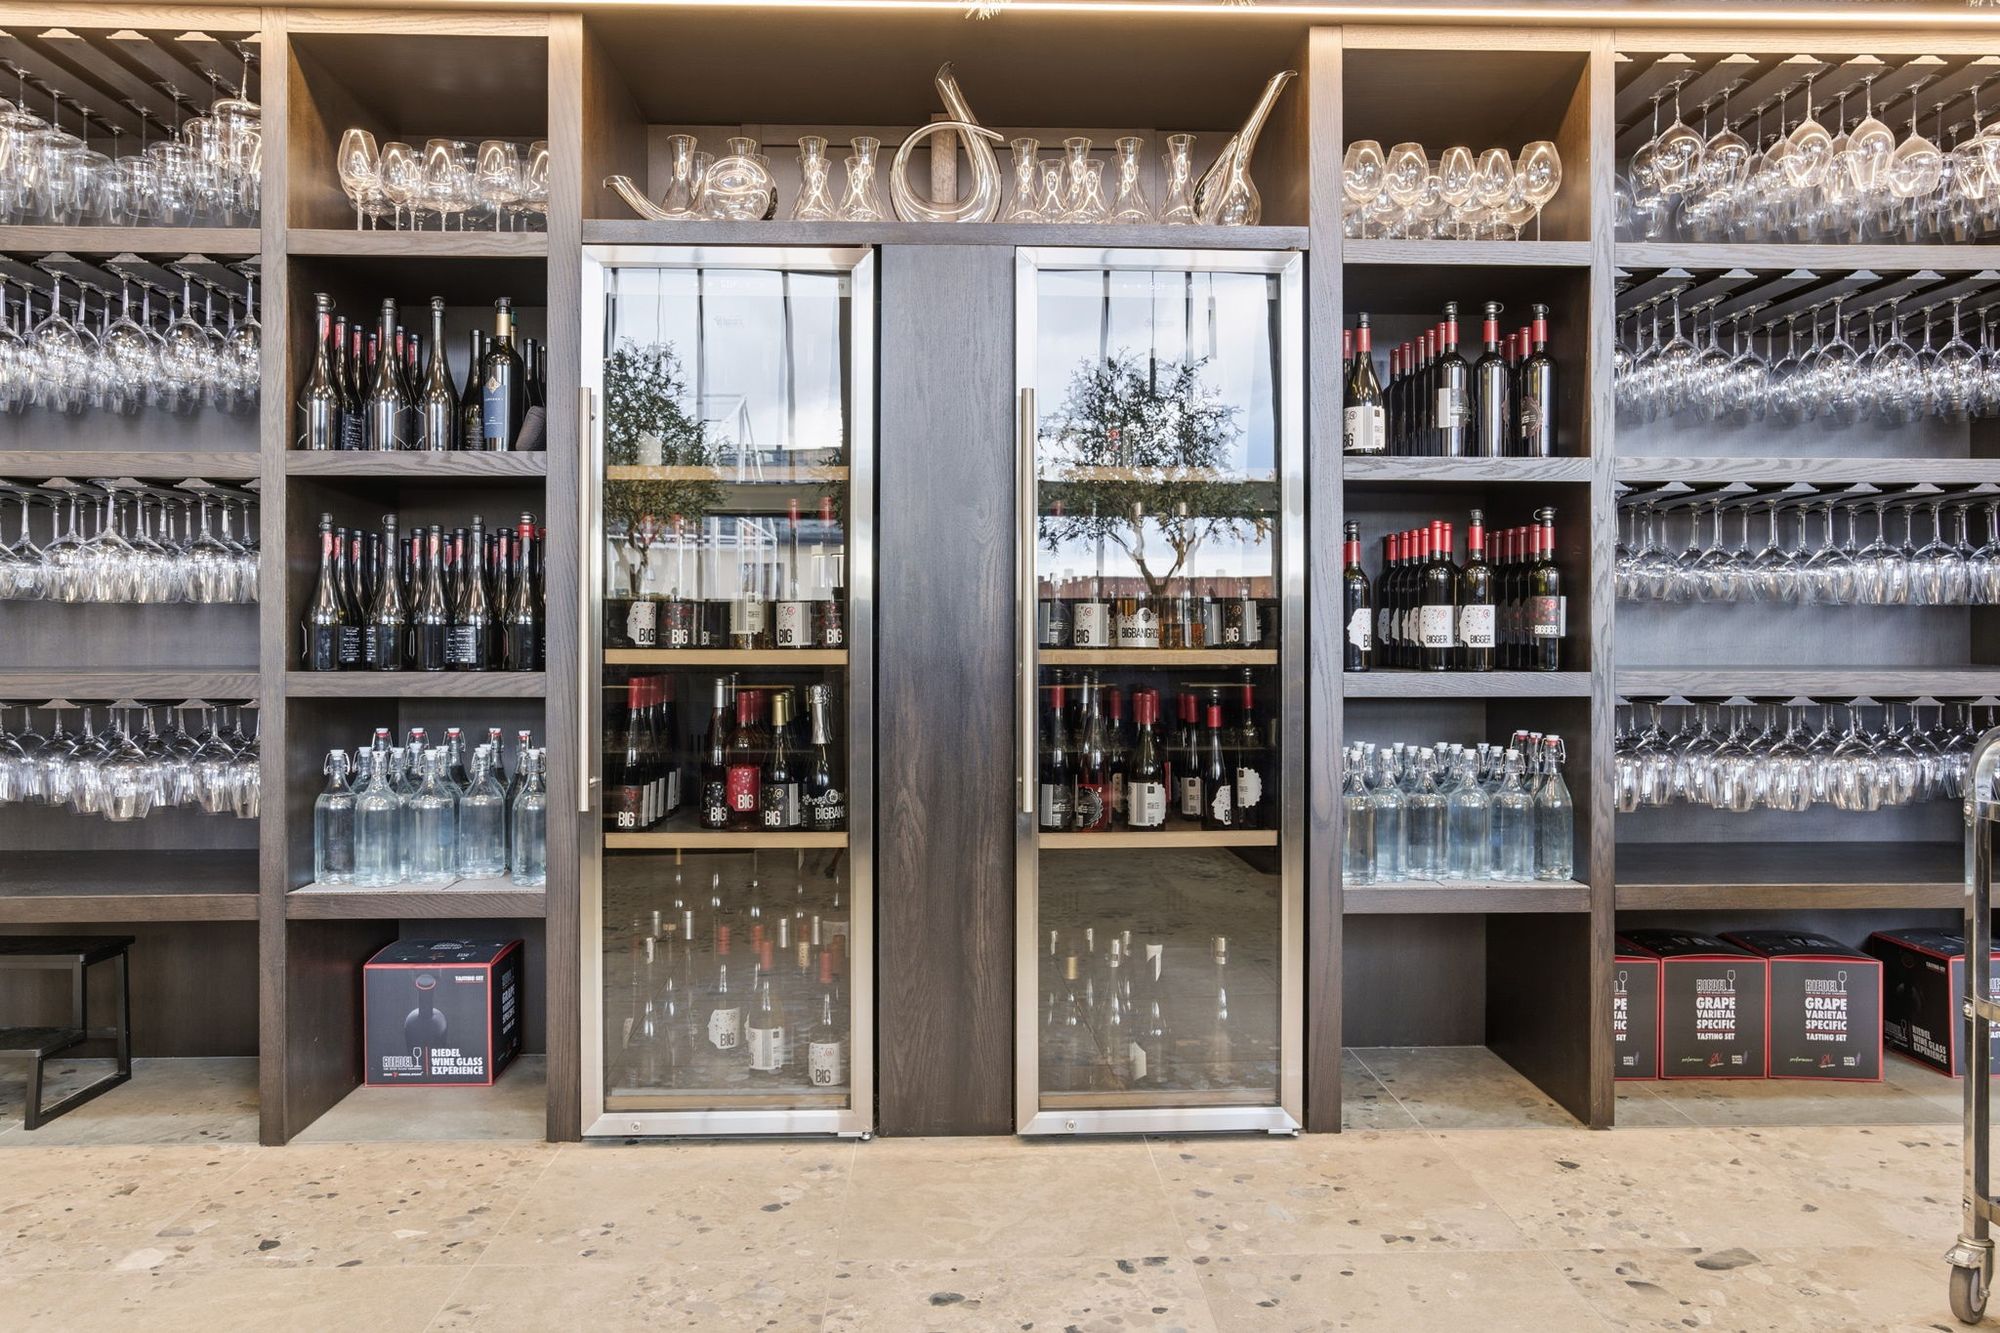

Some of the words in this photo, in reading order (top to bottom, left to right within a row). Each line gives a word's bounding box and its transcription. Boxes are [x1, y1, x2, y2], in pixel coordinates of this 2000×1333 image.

[671, 629, 688, 644] BIG
[778, 629, 793, 643] BIG
[826, 628, 842, 644] BIG
[1075, 629, 1090, 644] BIG
[1426, 634, 1448, 644] BIGGER
[737, 794, 754, 809] BIG
[618, 811, 635, 827] BIG
[710, 807, 727, 822] BIG
[764, 810, 780, 826] BIG
[1696, 996, 1736, 1009] GRAPE
[1805, 997, 1848, 1010] GRAPE
[1696, 1009, 1736, 1018] VARIETAL
[1805, 1010, 1847, 1020] VARIETAL
[1696, 1019, 1736, 1029] SPECIFIC
[1805, 1019, 1847, 1031] SPECIFIC
[720, 1032, 735, 1047] BIG
[1696, 1032, 1723, 1040] TASTING
[1806, 1033, 1834, 1041] TASTING
[1835, 1034, 1847, 1042] SET
[431, 1048, 461, 1057] RIEDEL
[431, 1057, 455, 1066] WINE
[456, 1057, 483, 1066] GLASS
[431, 1066, 484, 1075] EXPERIENCE
[815, 1068, 832, 1084] BIG
